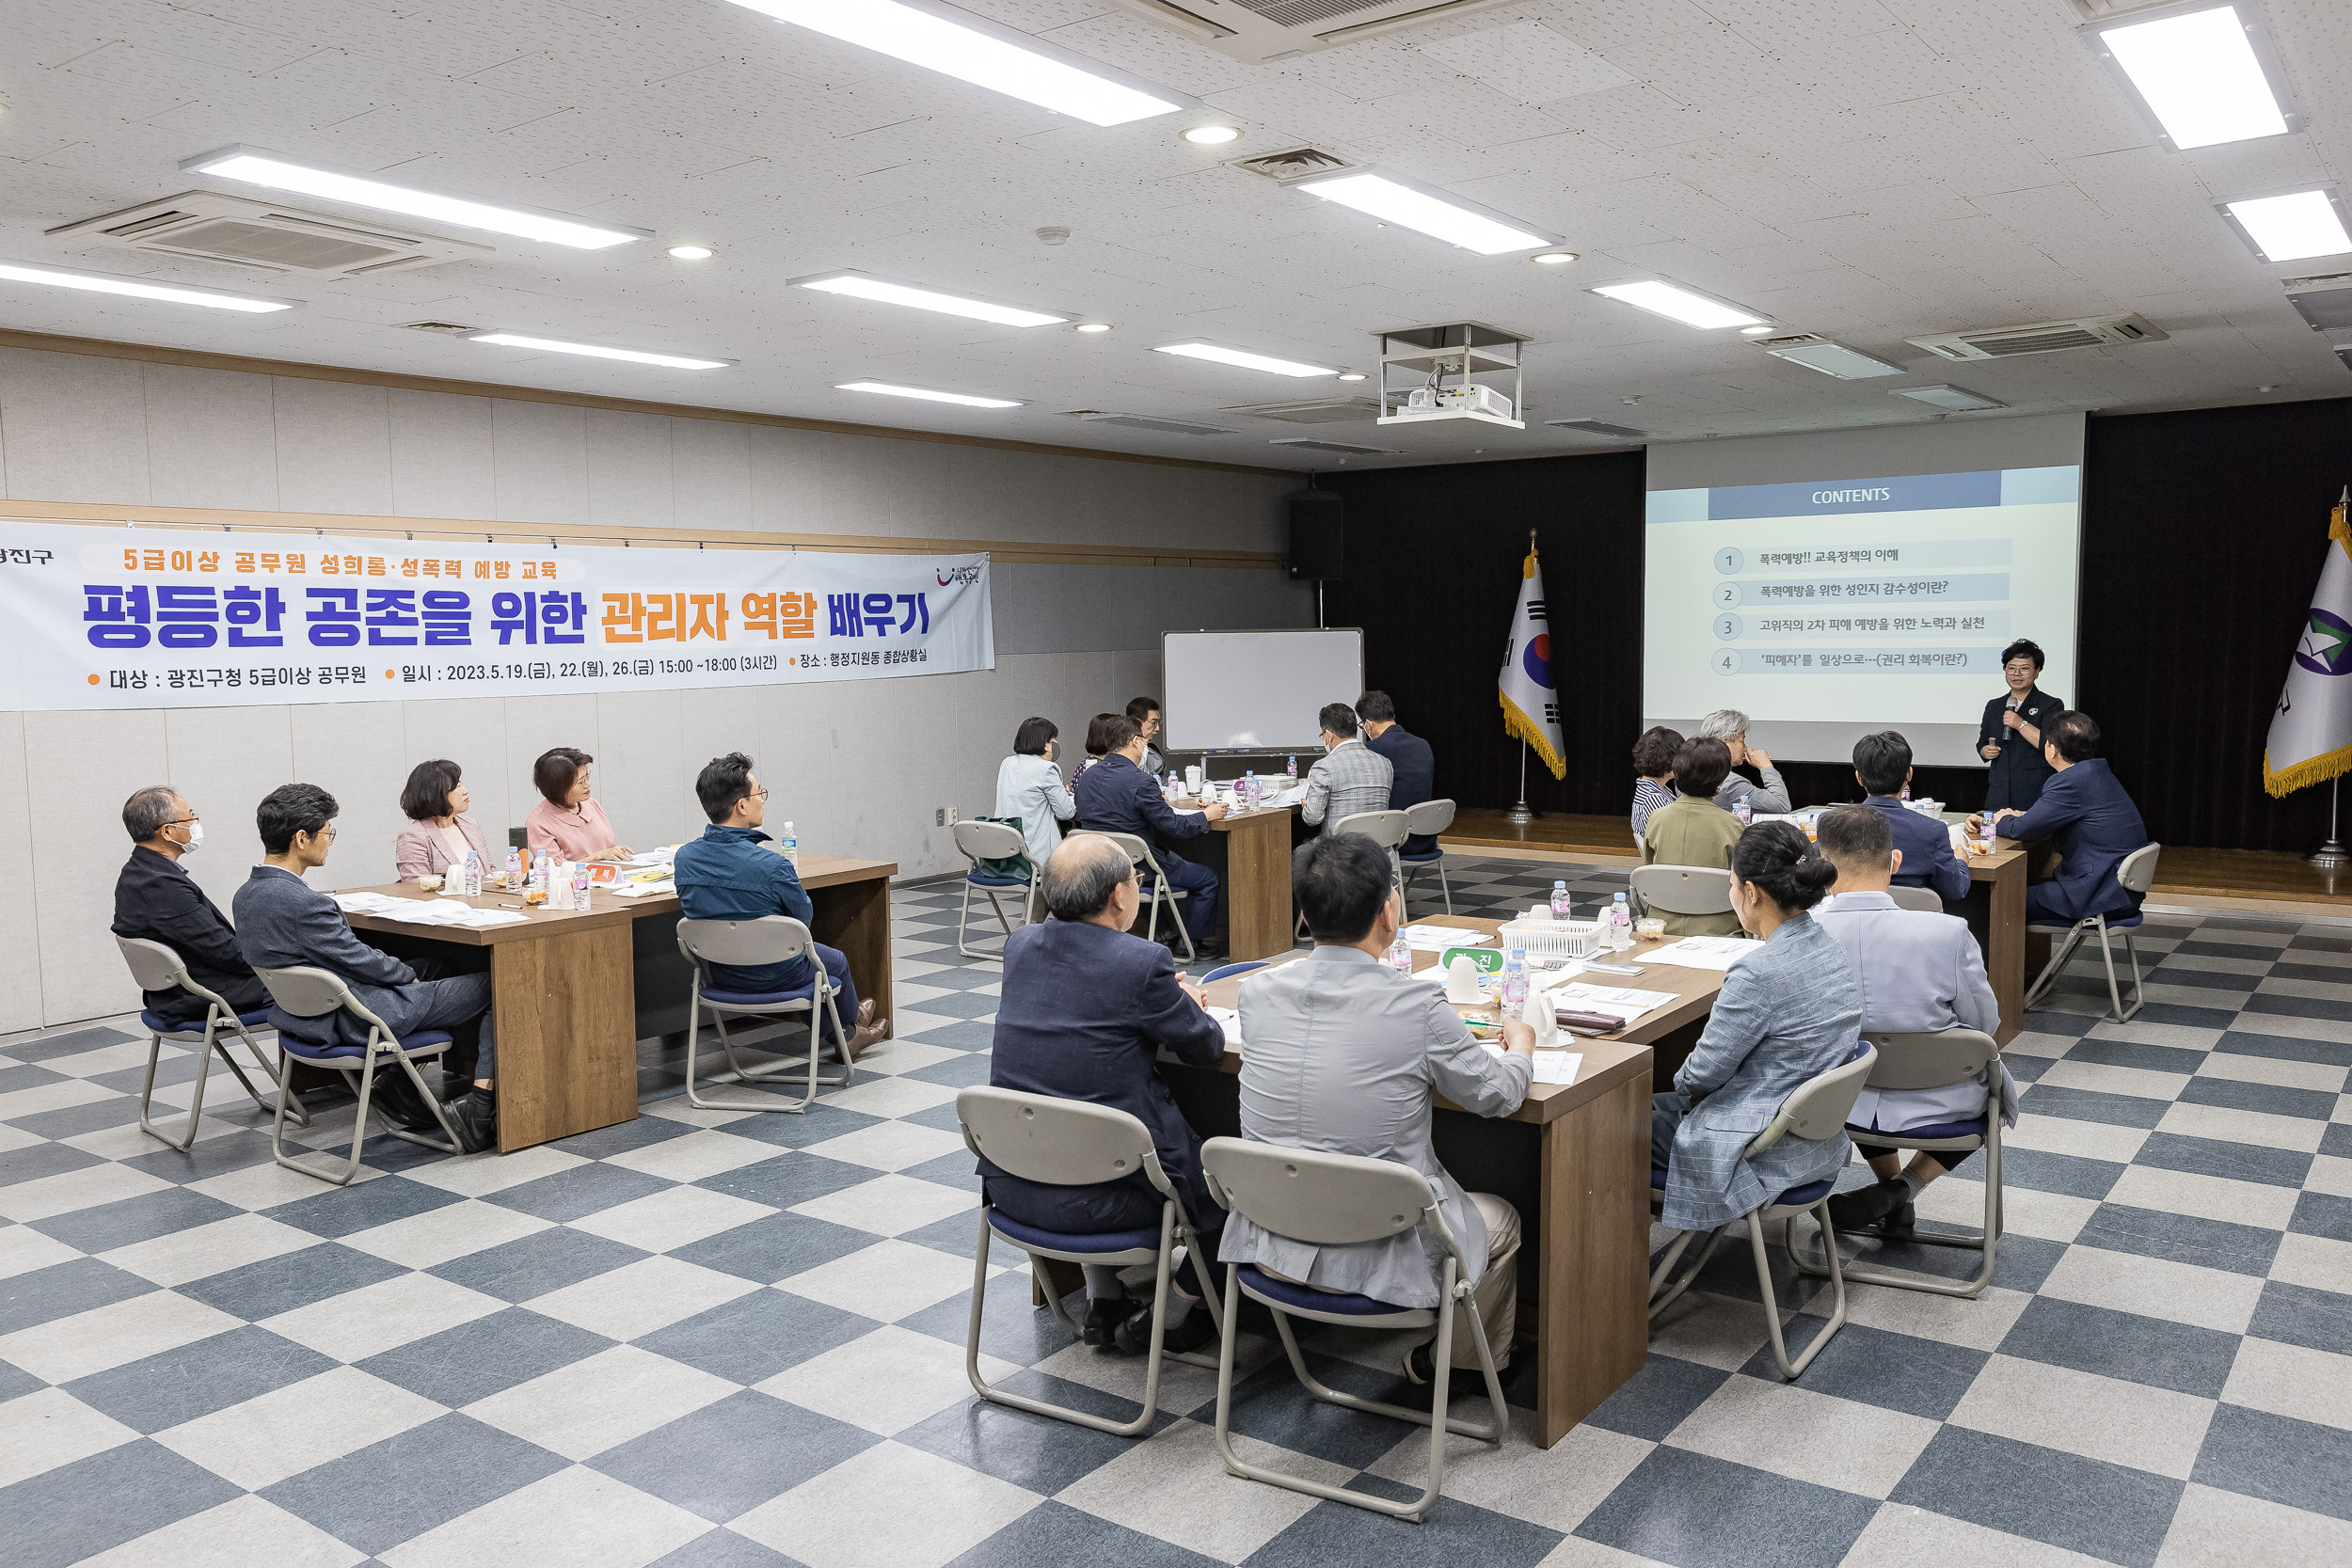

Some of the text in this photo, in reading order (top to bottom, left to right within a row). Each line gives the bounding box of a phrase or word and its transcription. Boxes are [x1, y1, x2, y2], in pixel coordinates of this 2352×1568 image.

[1812, 487, 1890, 504] CONTENTS
[123, 548, 220, 573] 5급이상
[234, 552, 307, 574] 공무원
[474, 560, 511, 579] 예방
[521, 561, 557, 579] 교육
[1725, 555, 1733, 566] 1
[1759, 548, 1899, 565] 폭력예방!! 교육정책의 이해
[1724, 590, 1733, 601] 2
[1760, 580, 1948, 598] 폭력예방을 위한 성인지 감수성이란?
[83, 584, 930, 649] 평등한 공존을 위한 관리자 역할 배우기
[1759, 616, 1985, 632] 고위직의 2차 피해 예방을 위한 노력과 실천
[1724, 622, 1732, 635] 3
[800, 654, 820, 668] 장소
[830, 651, 880, 667] 행정지원동
[882, 648, 928, 664] 종합상황실
[1722, 657, 1732, 670] 4
[1908, 653, 1968, 668] 회복이란?)
[109, 669, 149, 689] 대상
[167, 667, 242, 689] 광진구청
[248, 666, 311, 686] 5급이상
[317, 665, 366, 685] 공무원
[402, 664, 431, 683] 일시
[447, 660, 555, 681] 2023.5.19.(금),
[560, 659, 609, 679] 22.(월),
[612, 658, 654, 676] 26.(금)
[659, 658, 693, 673] 15:00
[696, 657, 737, 673] ~18:00
[740, 654, 778, 671] (3시간)
